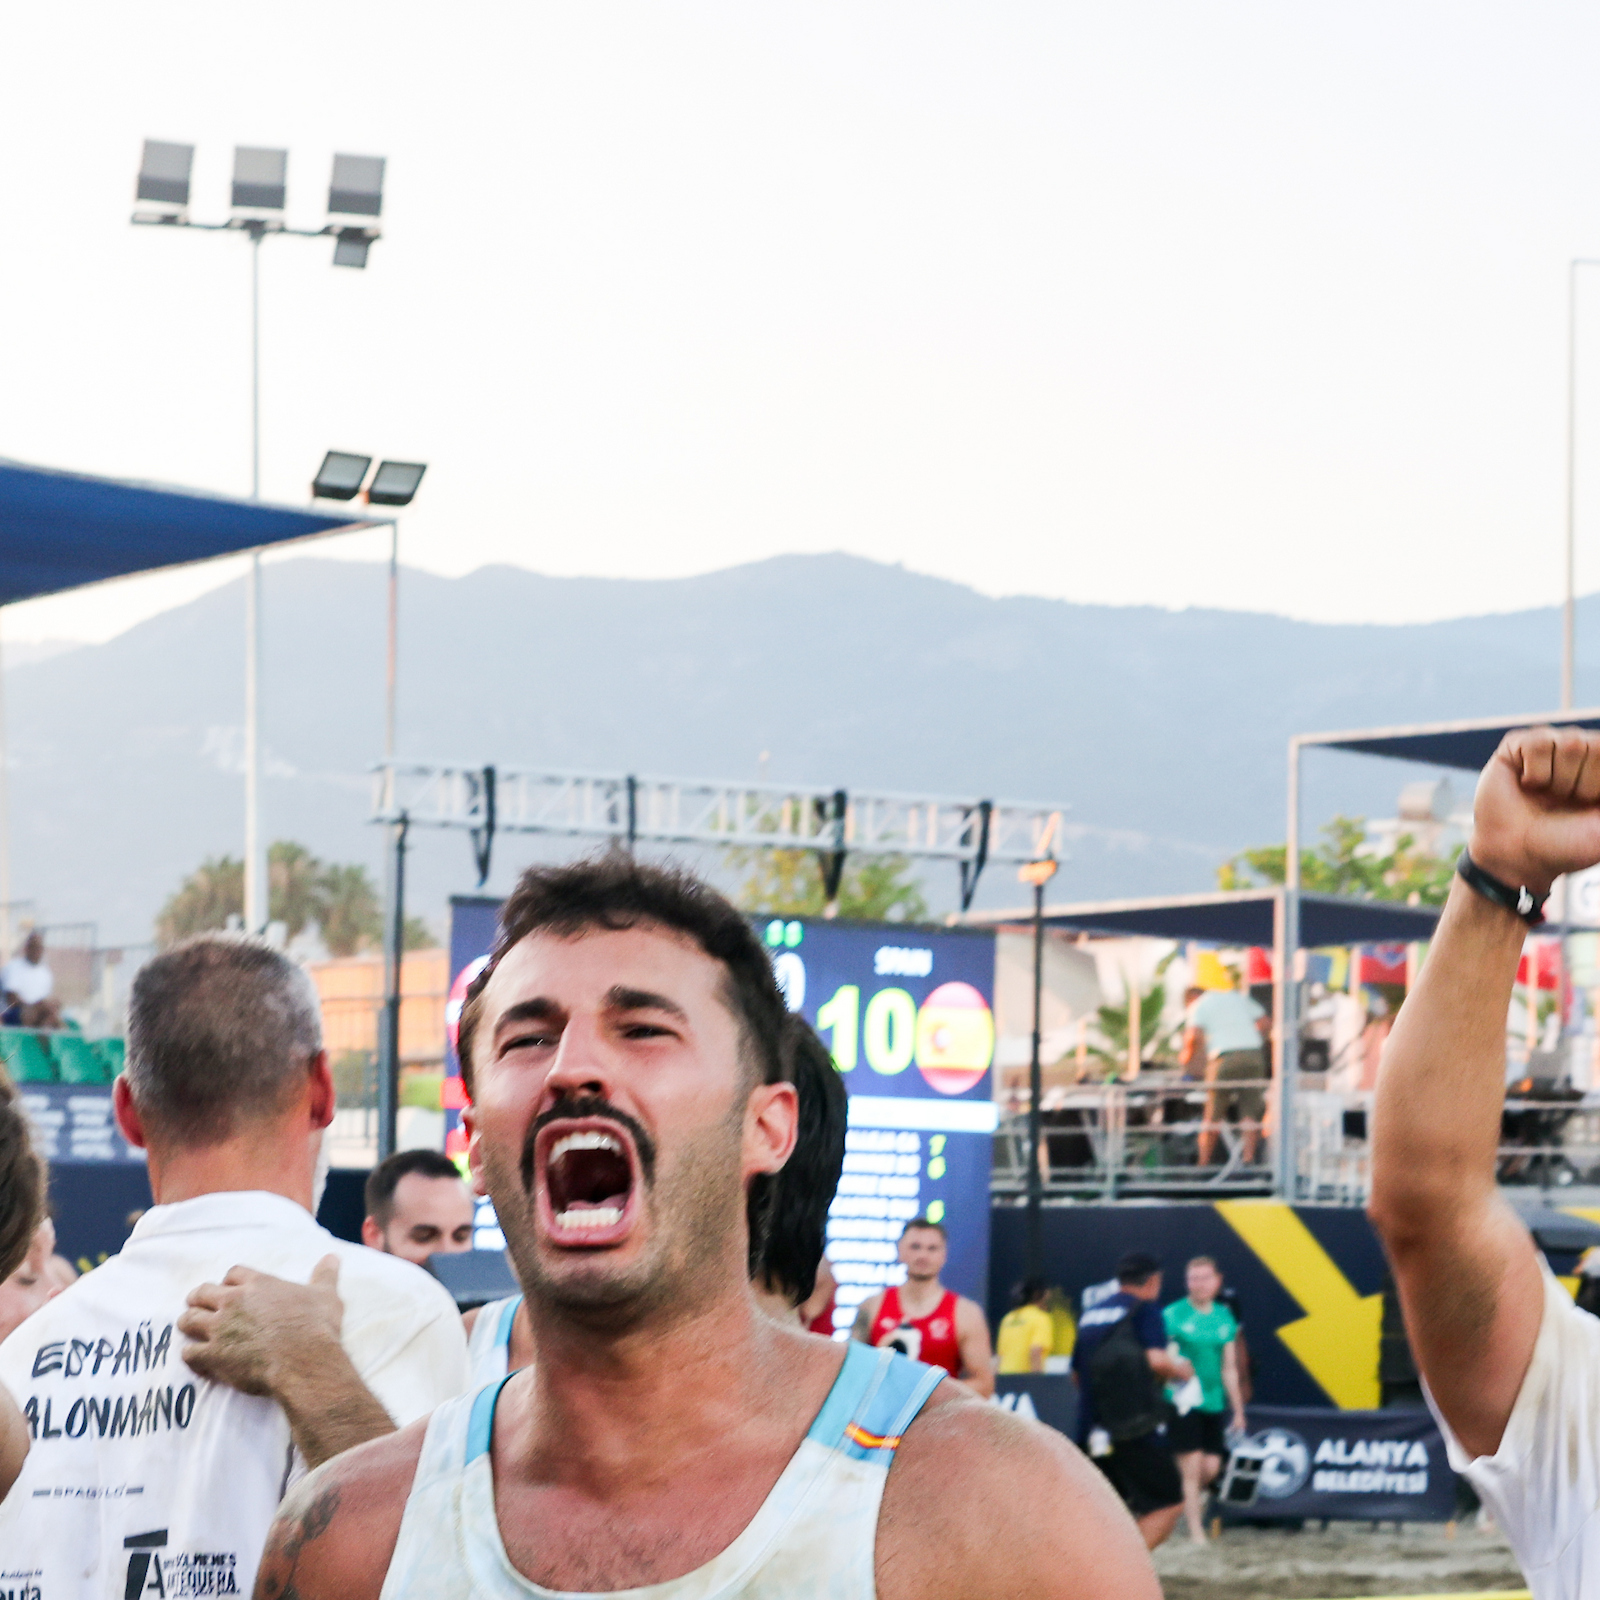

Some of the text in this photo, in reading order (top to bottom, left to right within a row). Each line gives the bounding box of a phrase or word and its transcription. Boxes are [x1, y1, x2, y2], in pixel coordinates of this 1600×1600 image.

[817, 984, 918, 1076] 10
[31, 1319, 173, 1378] ESPAÑA
[22, 1383, 196, 1440] ALONMANO
[1313, 1438, 1429, 1467] ALANYA
